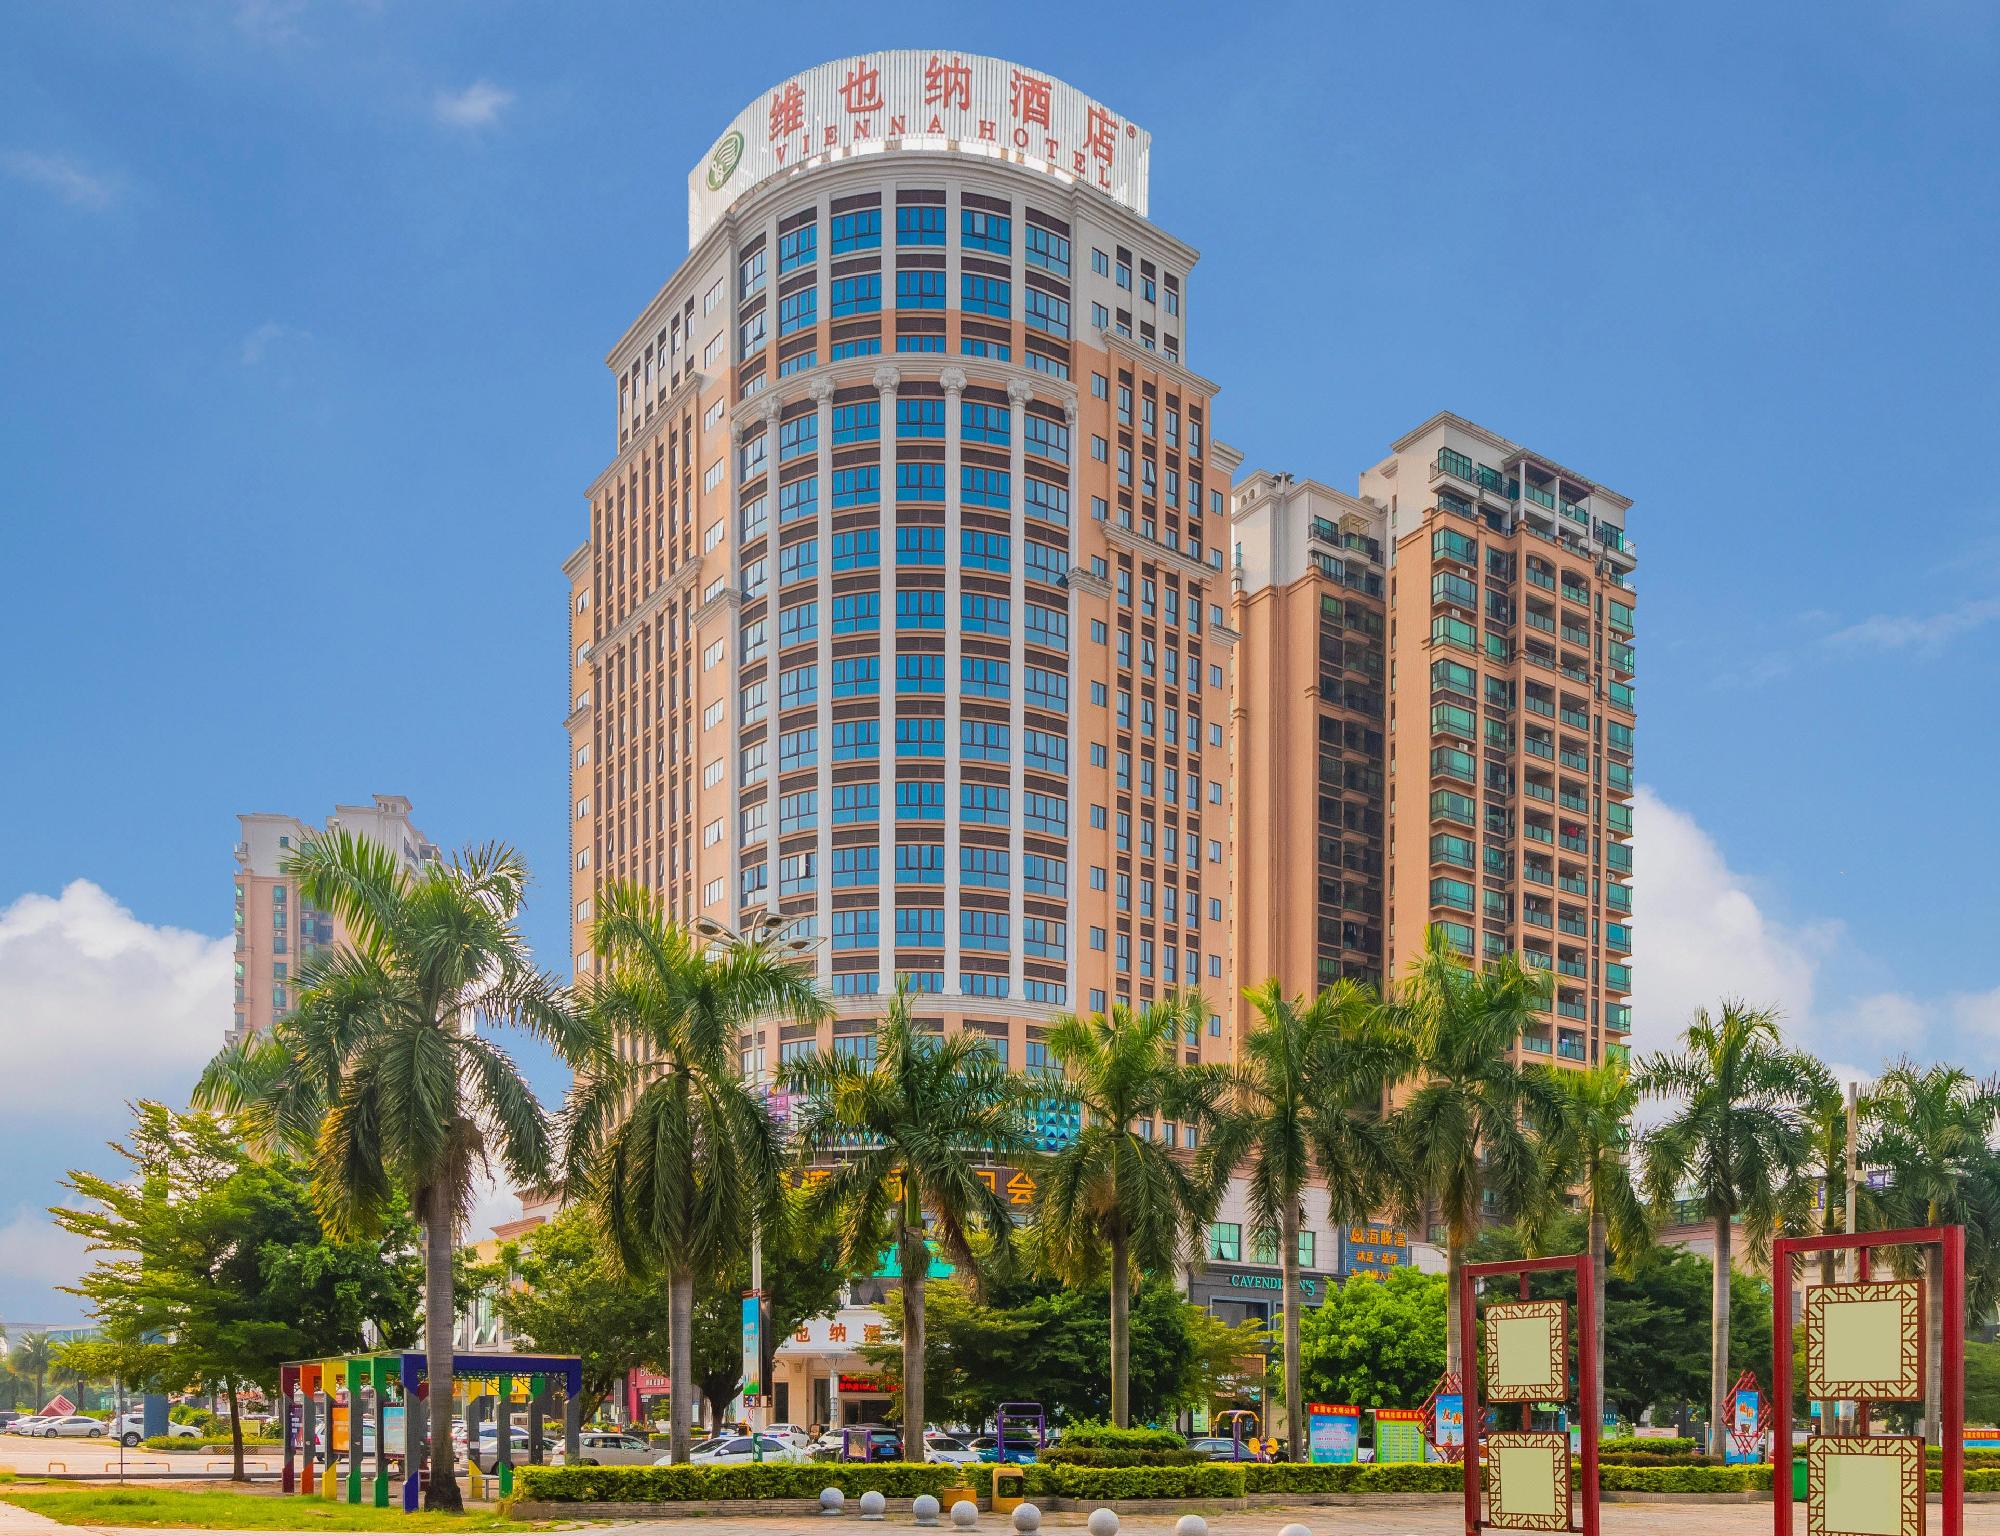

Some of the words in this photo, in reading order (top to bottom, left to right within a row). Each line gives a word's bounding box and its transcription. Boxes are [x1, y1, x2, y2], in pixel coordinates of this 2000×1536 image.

[768, 56, 1118, 168] 维也纳酒店
[776, 115, 945, 166] VIENNA
[978, 120, 1112, 189] HOTEL
